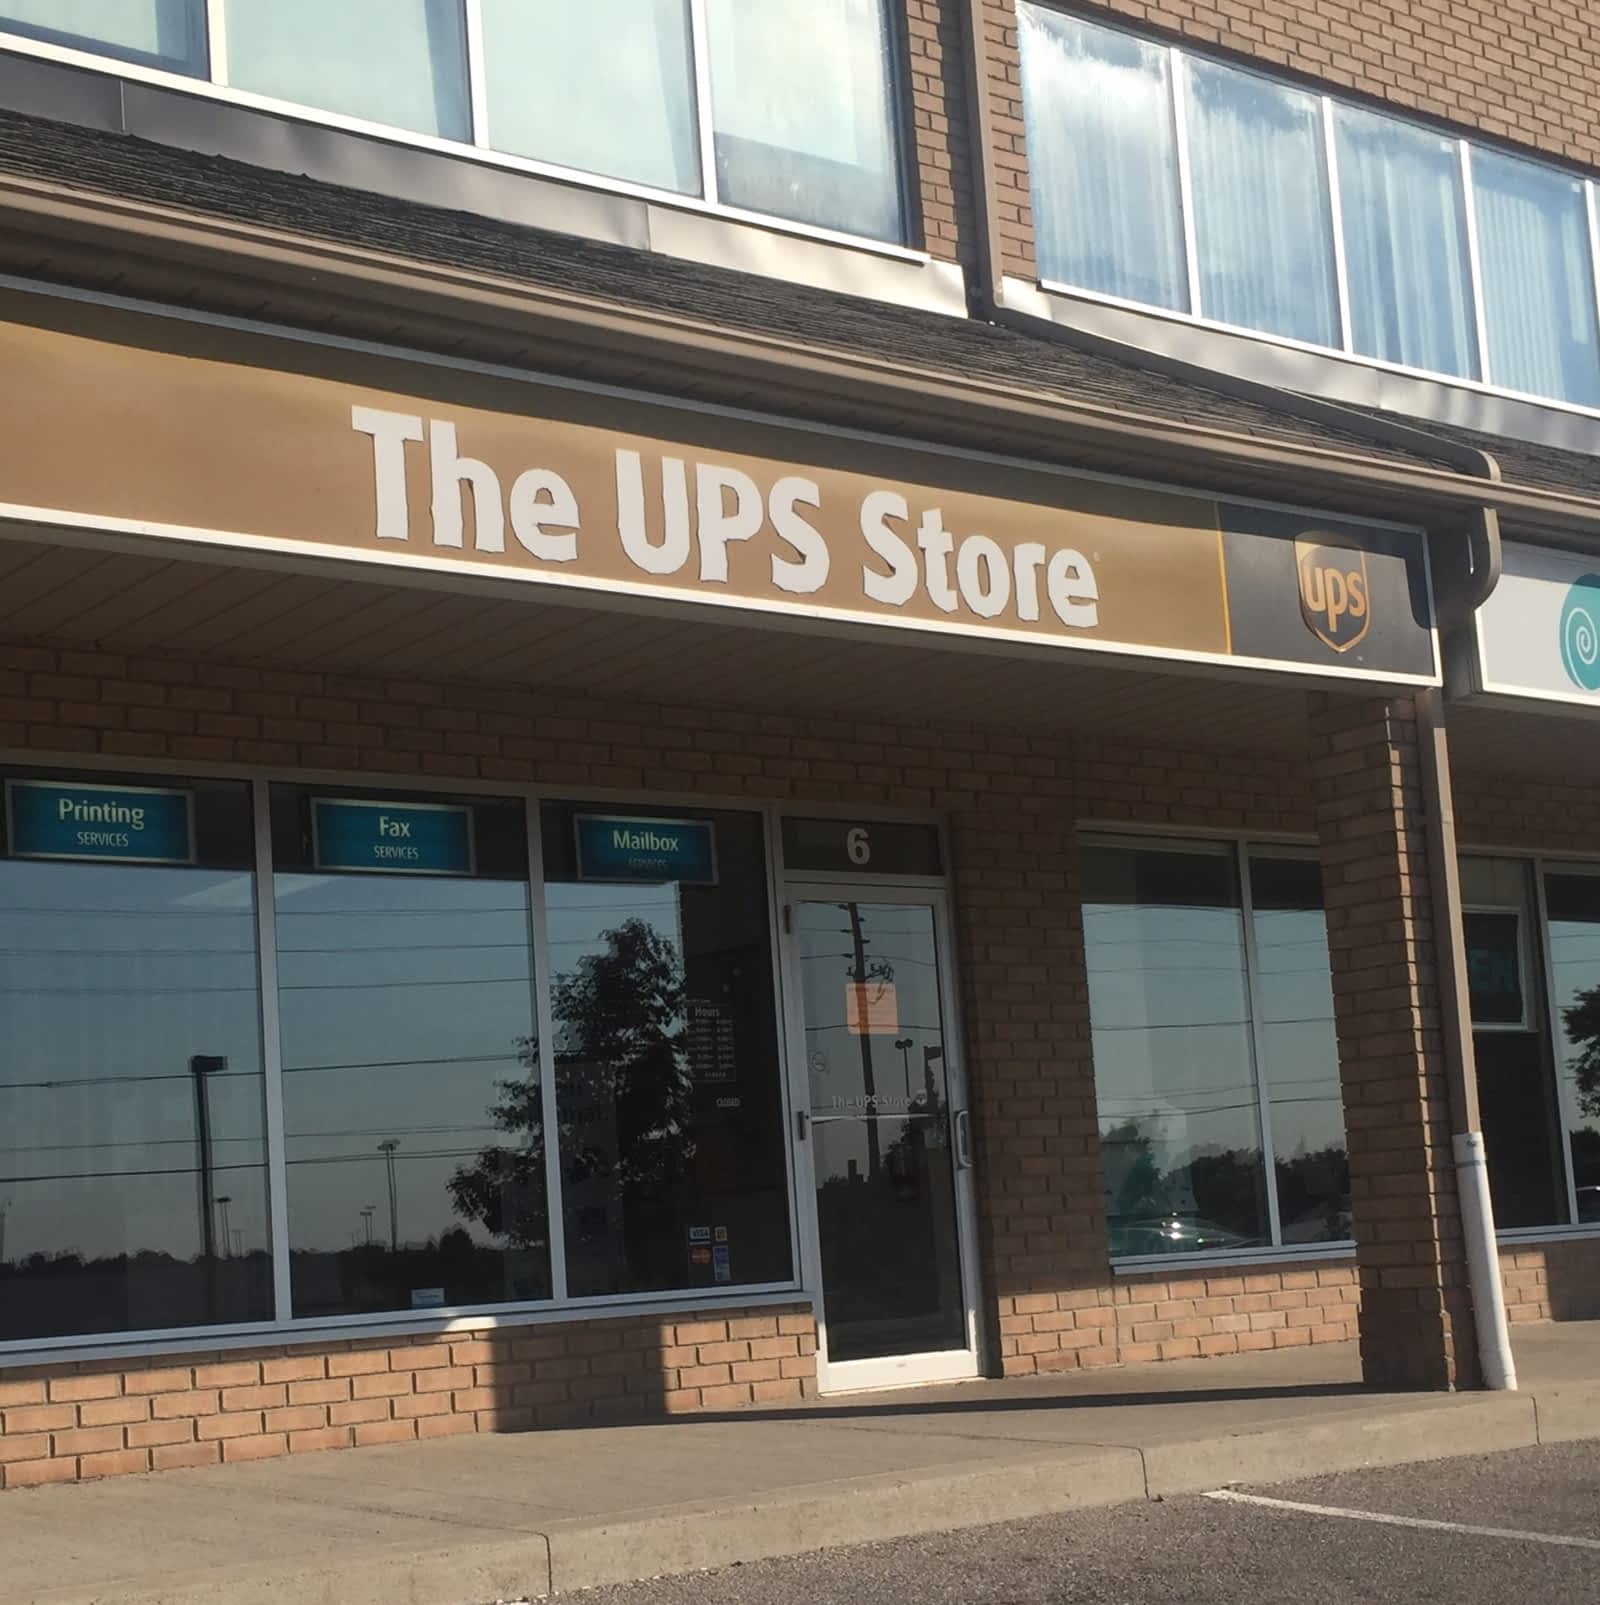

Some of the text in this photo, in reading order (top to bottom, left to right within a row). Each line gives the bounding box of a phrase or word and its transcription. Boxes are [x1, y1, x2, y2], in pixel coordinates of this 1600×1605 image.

[352, 404, 1099, 628] The UPS Store
[1303, 566, 1366, 632] ups
[58, 798, 145, 831] Printing
[378, 815, 411, 837] Fax
[76, 831, 129, 847] SERVICES
[612, 829, 680, 852] Mailbox
[847, 828, 871, 865] 6
[373, 844, 419, 860] SERVICES
[855, 1094, 879, 1109] UPS
